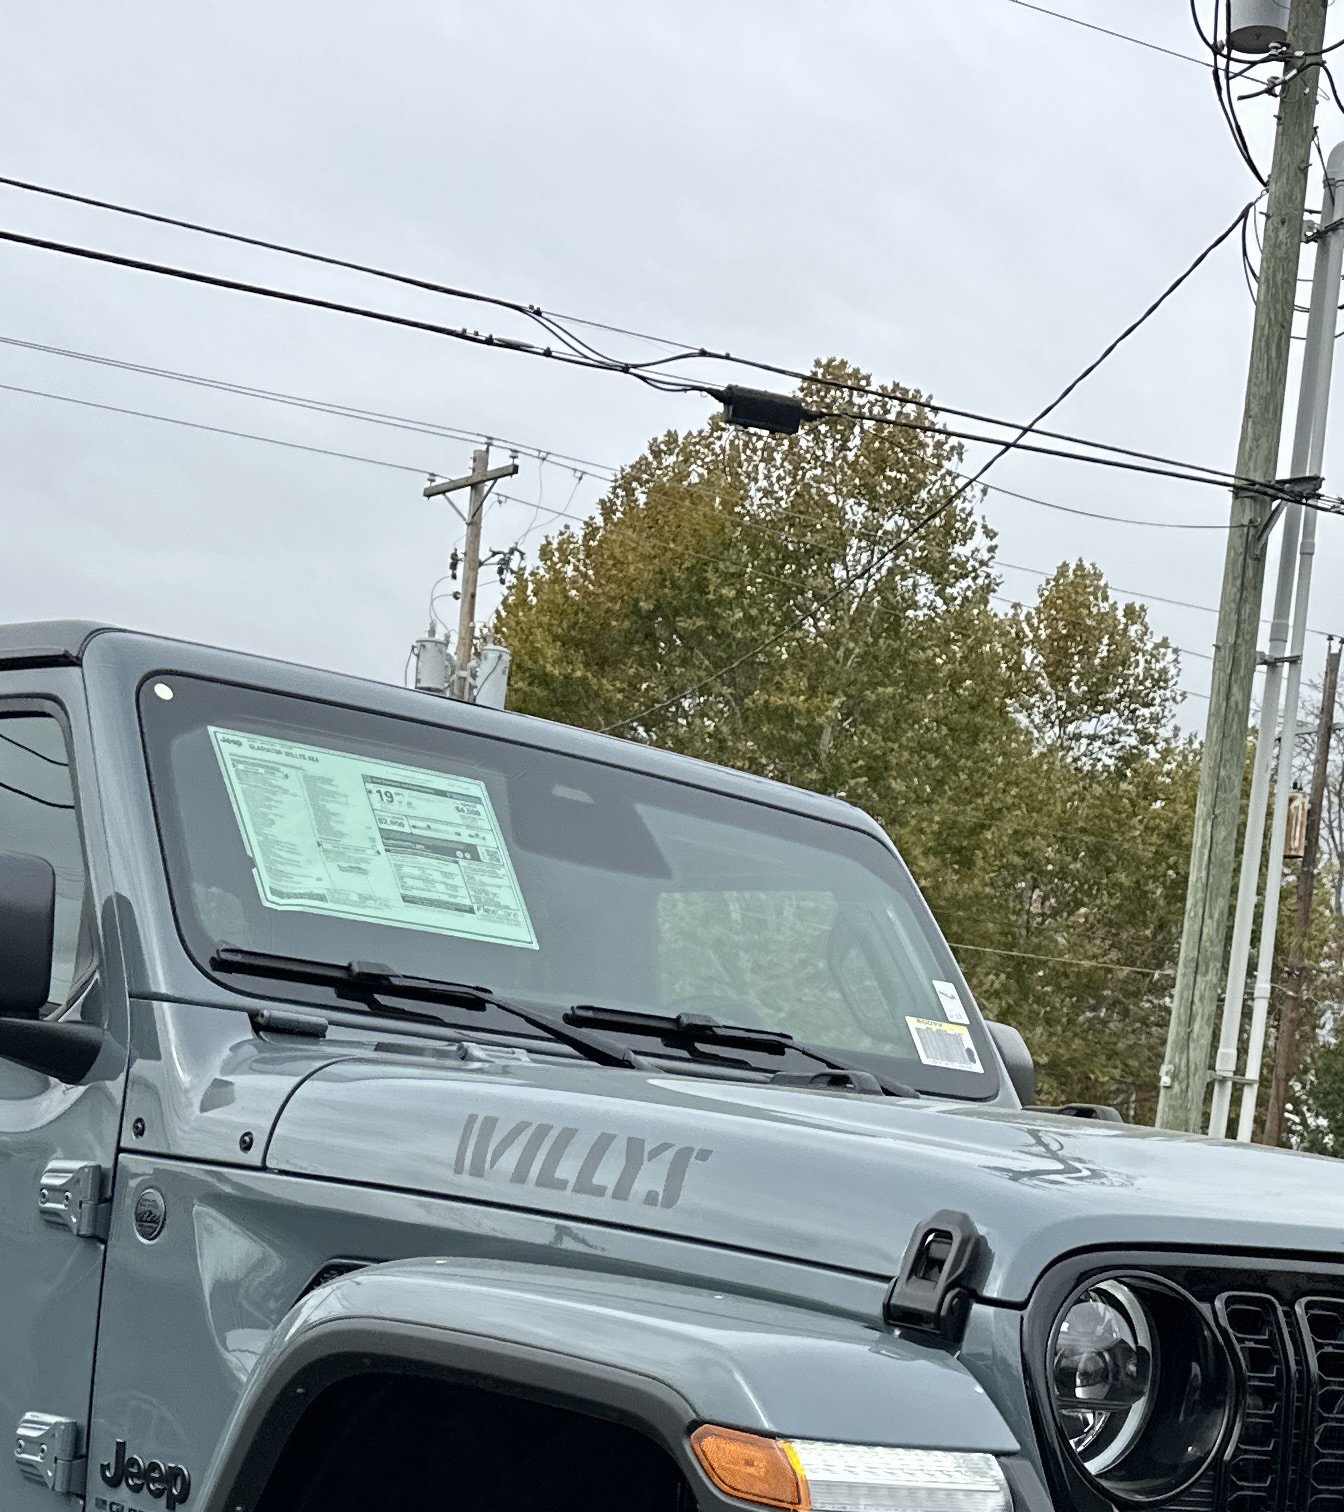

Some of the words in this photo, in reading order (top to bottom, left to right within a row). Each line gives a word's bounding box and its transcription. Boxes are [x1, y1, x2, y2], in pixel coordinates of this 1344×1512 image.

[376, 789, 394, 803] 19
[454, 1113, 713, 1209] WILLYS
[100, 1438, 192, 1512] Jeep
